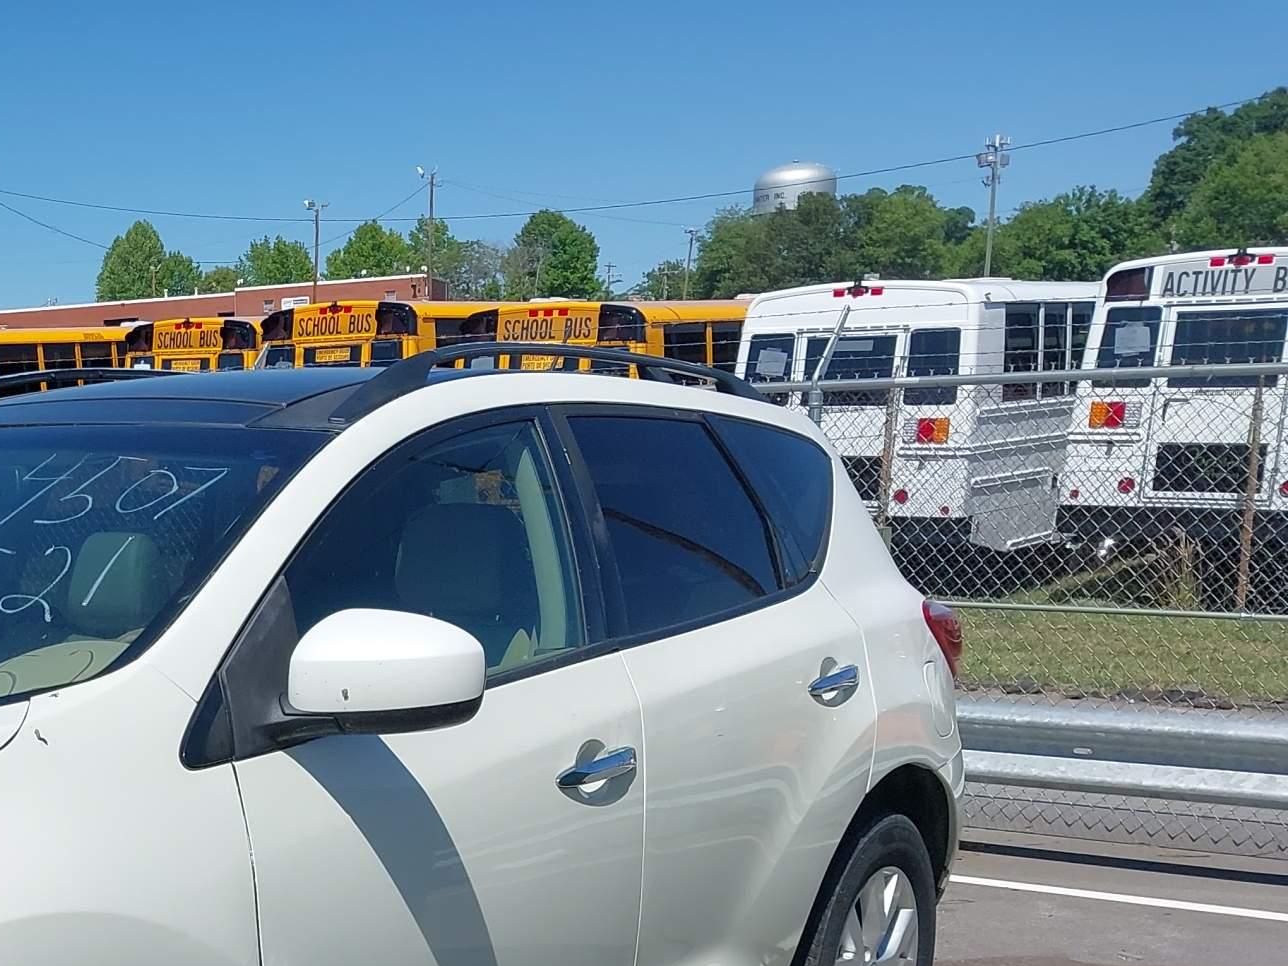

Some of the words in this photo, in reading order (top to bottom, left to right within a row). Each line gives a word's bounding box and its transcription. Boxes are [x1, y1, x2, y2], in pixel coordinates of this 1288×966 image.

[1162, 268, 1256, 298] ACTIVITY
[298, 316, 341, 336] SCHOOL
[348, 314, 372, 333] BUS
[503, 318, 555, 341] SCHOOL
[158, 331, 193, 349] SCHOOL
[199, 330, 218, 347] BUS
